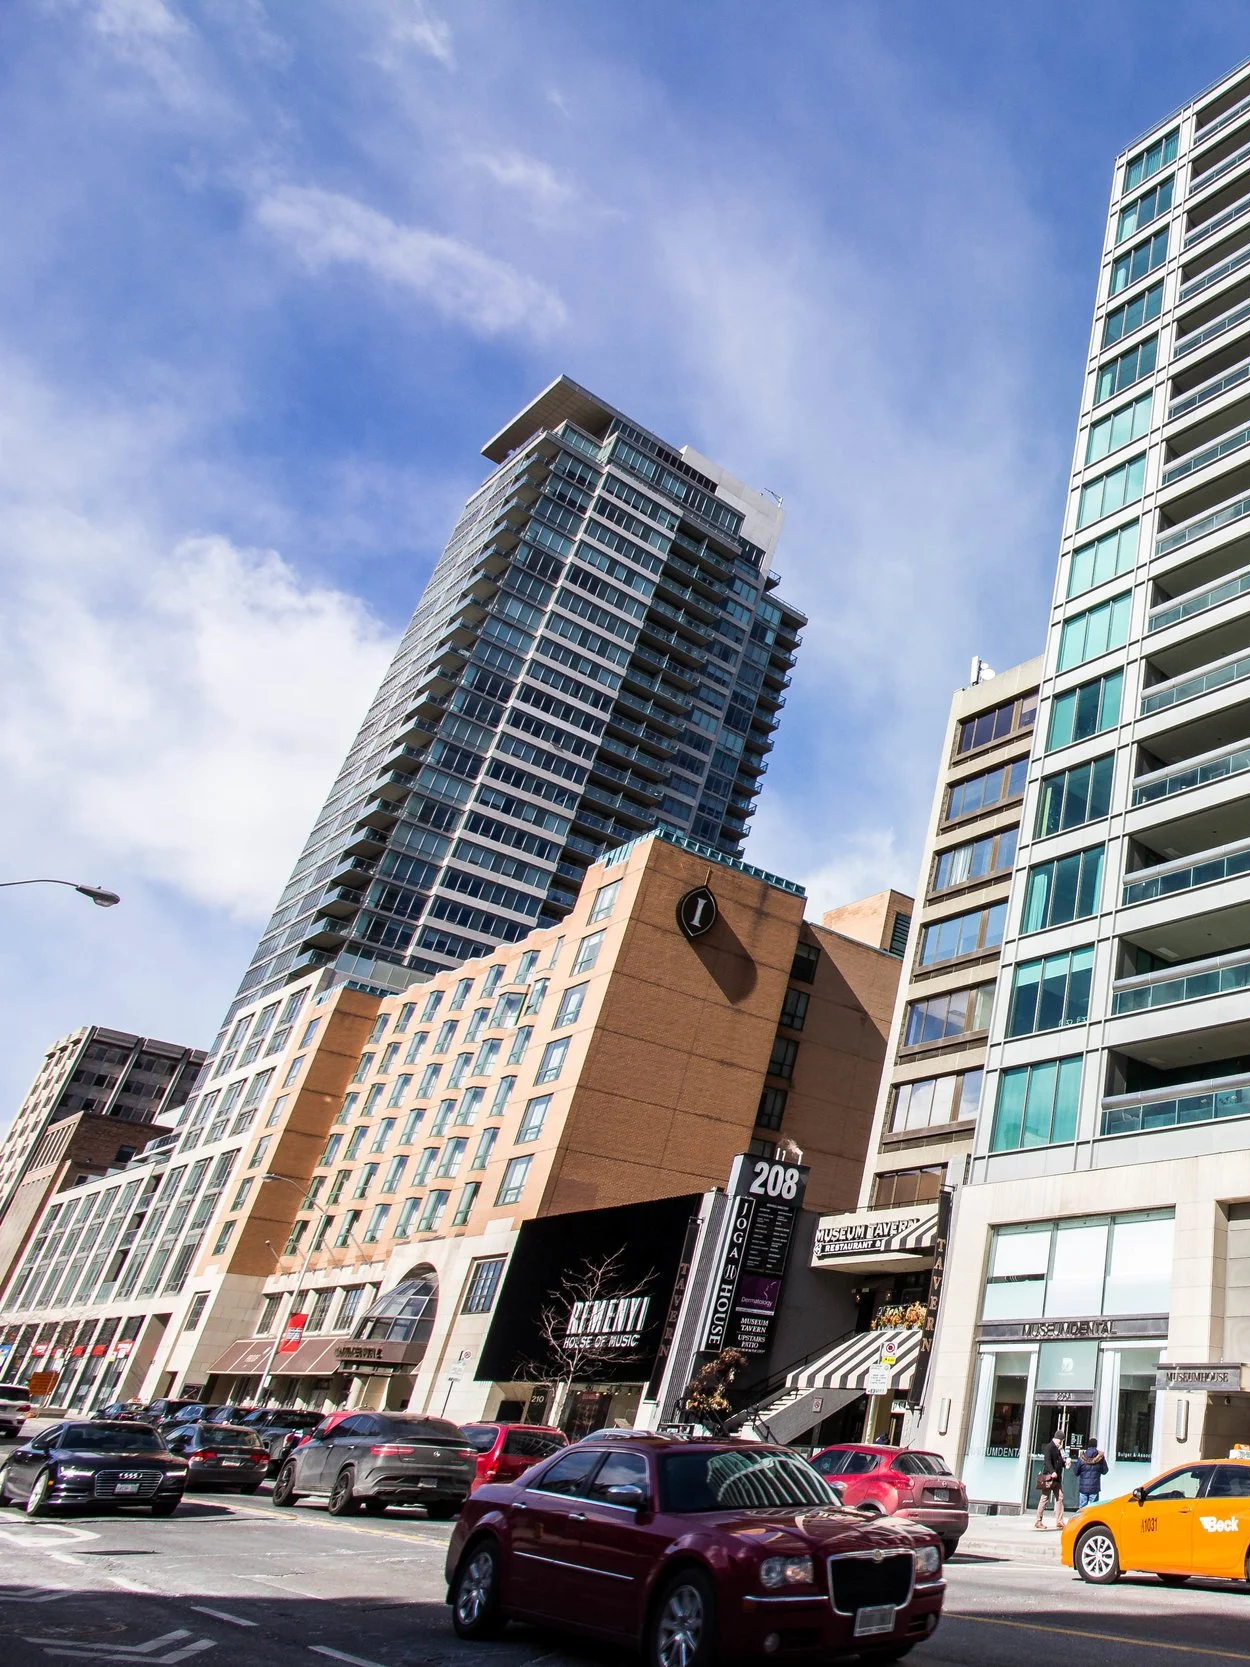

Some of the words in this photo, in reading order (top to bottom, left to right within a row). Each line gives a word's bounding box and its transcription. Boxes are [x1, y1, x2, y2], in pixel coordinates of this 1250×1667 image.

[749, 1161, 800, 1200] 208
[729, 1202, 749, 1259] JOGA
[815, 1226, 866, 1242] MUSEUM
[825, 1241, 872, 1252] RESTAURANT
[741, 1296, 773, 1308] Dermatology
[920, 1238, 946, 1352] TAVERN
[566, 1297, 650, 1334] REMENYI
[659, 1262, 690, 1357] TAVERN
[708, 1284, 733, 1344] HOUSE
[741, 1317, 769, 1326] MUSEUM
[741, 1324, 767, 1333] TAVERN
[594, 1336, 608, 1348] OF
[608, 1334, 640, 1348] MUSIC
[738, 1334, 766, 1343] UPSTAIRS
[741, 1341, 759, 1349] PATIO
[531, 1395, 545, 1403] 210
